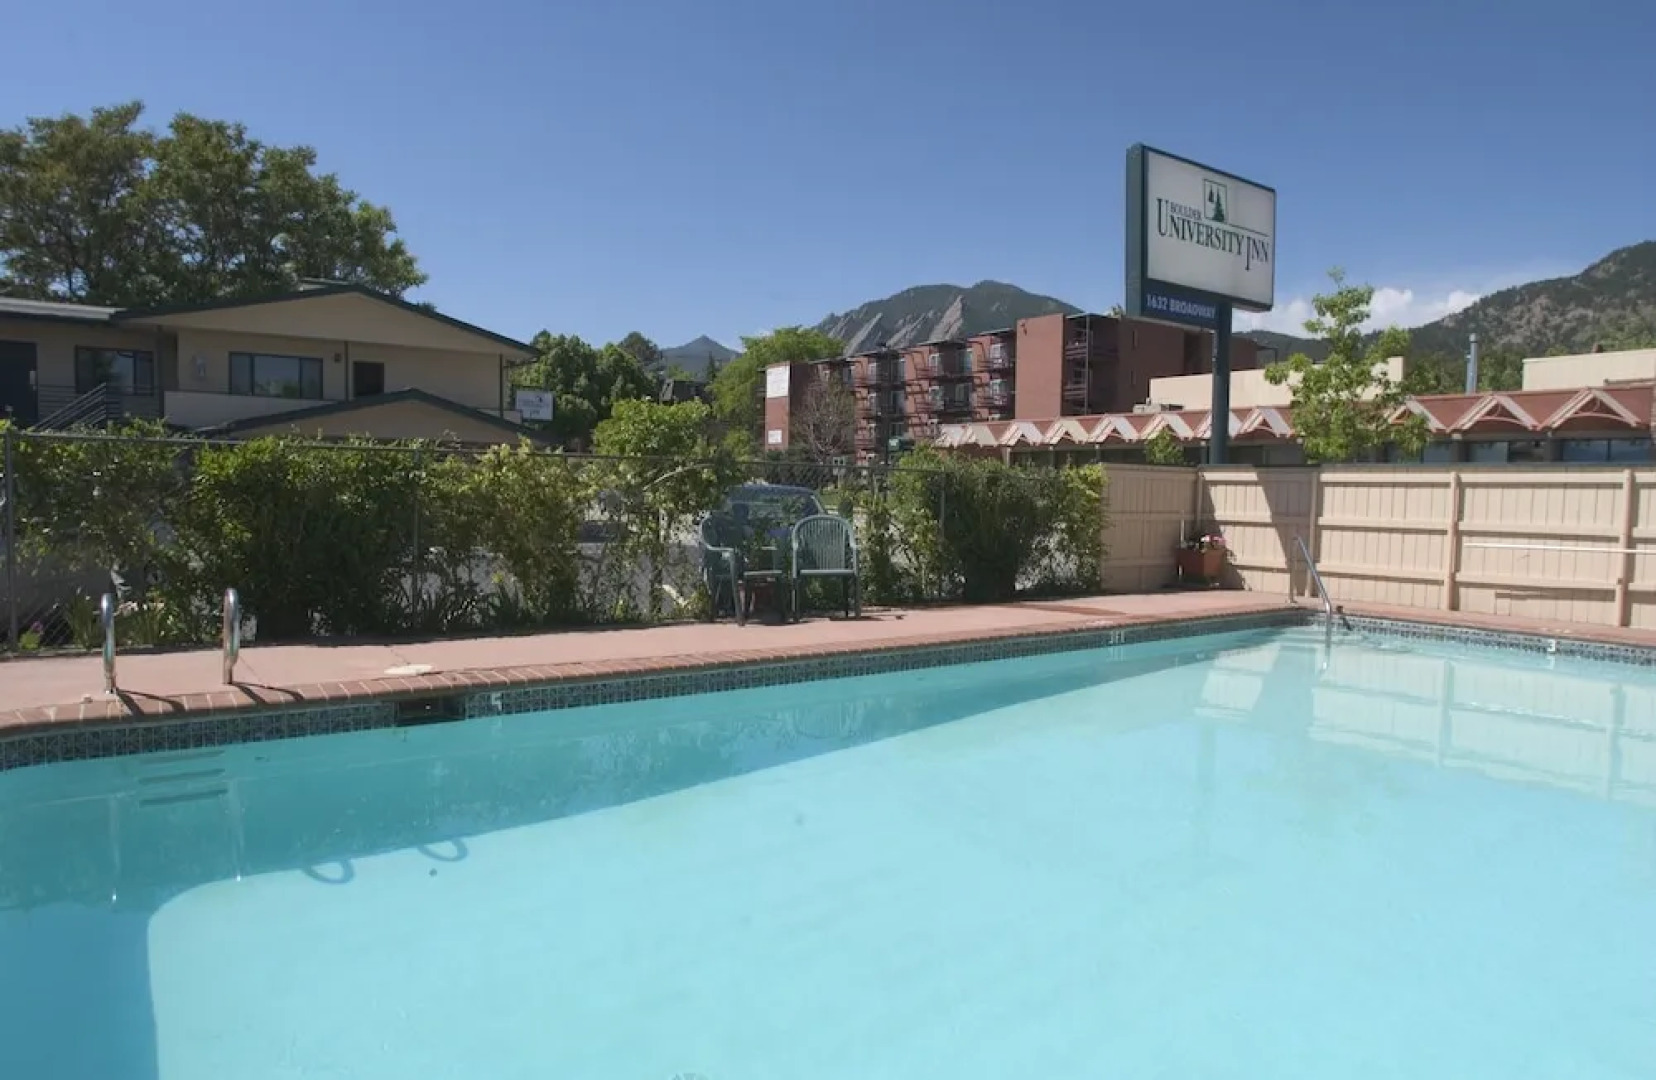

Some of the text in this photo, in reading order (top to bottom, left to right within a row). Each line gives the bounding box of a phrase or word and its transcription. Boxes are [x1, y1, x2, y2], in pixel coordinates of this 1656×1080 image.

[1171, 202, 1201, 220] BOULDER
[1156, 198, 1269, 270] UNIVERSITY INN
[1170, 298, 1216, 319] BROADWAY
